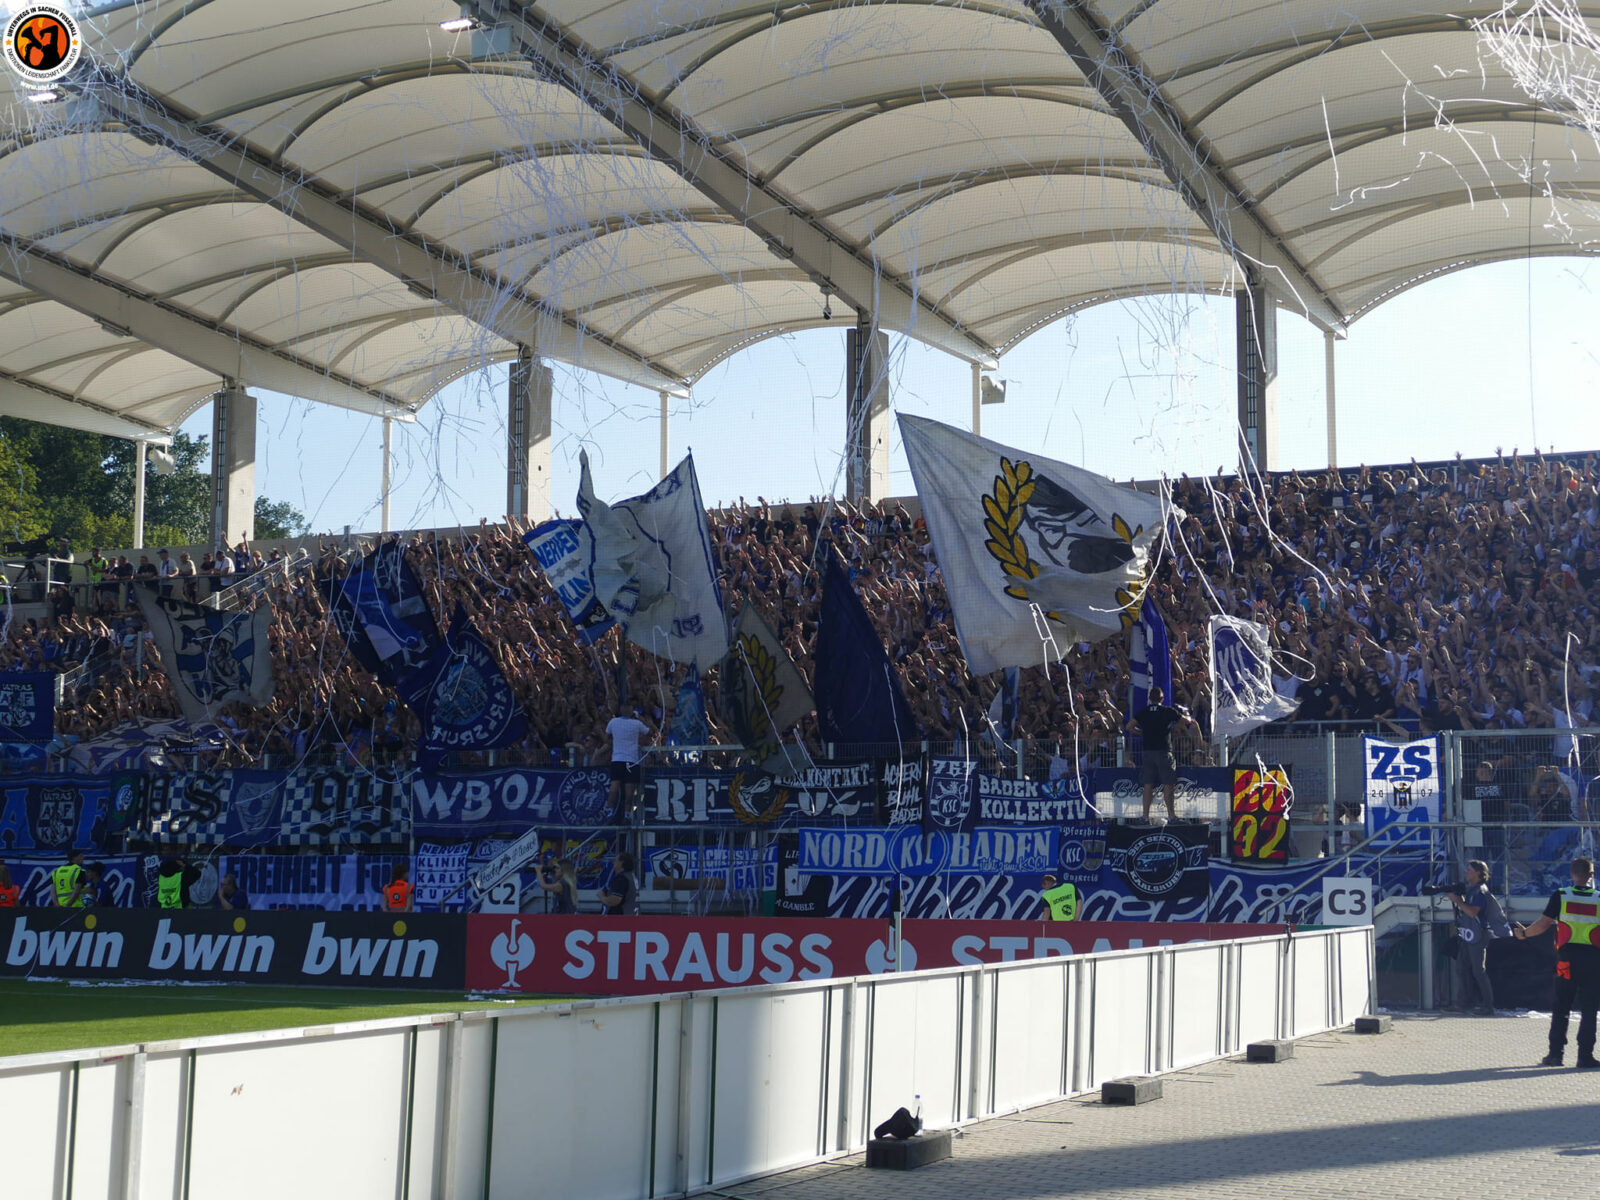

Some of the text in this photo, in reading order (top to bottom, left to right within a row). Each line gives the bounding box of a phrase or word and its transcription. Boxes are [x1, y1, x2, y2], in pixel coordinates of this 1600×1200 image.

[1371, 744, 1433, 780] ZS
[564, 771, 586, 793] WILD
[979, 774, 1038, 797] BADEN
[980, 798, 1088, 822] KOLLEKTIV
[803, 832, 887, 868] NORD
[950, 831, 1051, 868] BADEN
[1065, 847, 1081, 865] KSC
[1146, 835, 1185, 854] SEKTION
[418, 856, 466, 868] KLINIK
[226, 856, 347, 893] FREIHEIT
[418, 872, 466, 884] KARLS
[1130, 870, 1182, 892] KARLSRUHE
[417, 887, 465, 899] RUHE
[487, 882, 516, 905] C2
[1328, 888, 1367, 916] C3
[5, 914, 125, 968] bwin
[148, 916, 276, 973] bwin
[301, 920, 439, 978] bwin
[562, 928, 834, 984] STRAUSS
